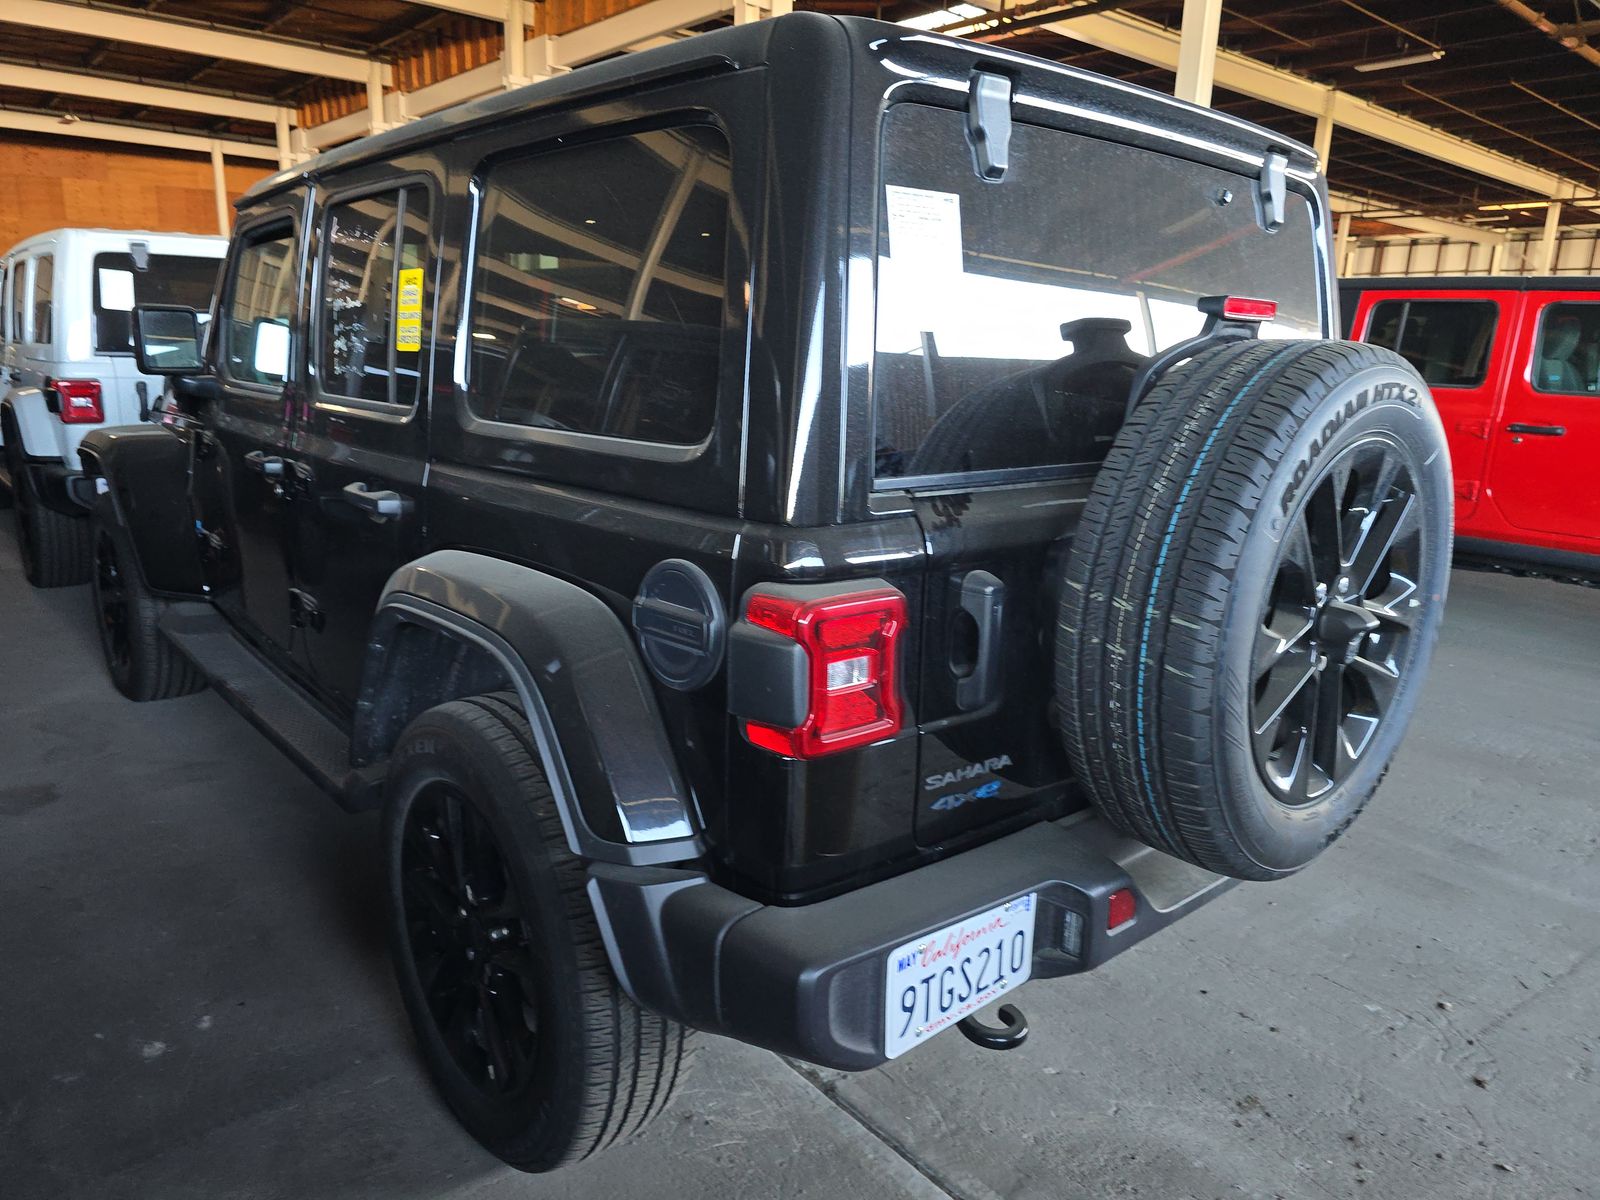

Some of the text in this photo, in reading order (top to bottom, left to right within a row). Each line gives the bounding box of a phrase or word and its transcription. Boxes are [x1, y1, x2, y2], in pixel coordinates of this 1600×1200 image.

[924, 754, 1014, 790] SAHARA
[897, 949, 917, 973] MAY
[918, 916, 1008, 968] California
[900, 929, 1024, 1038] 9TGS210
